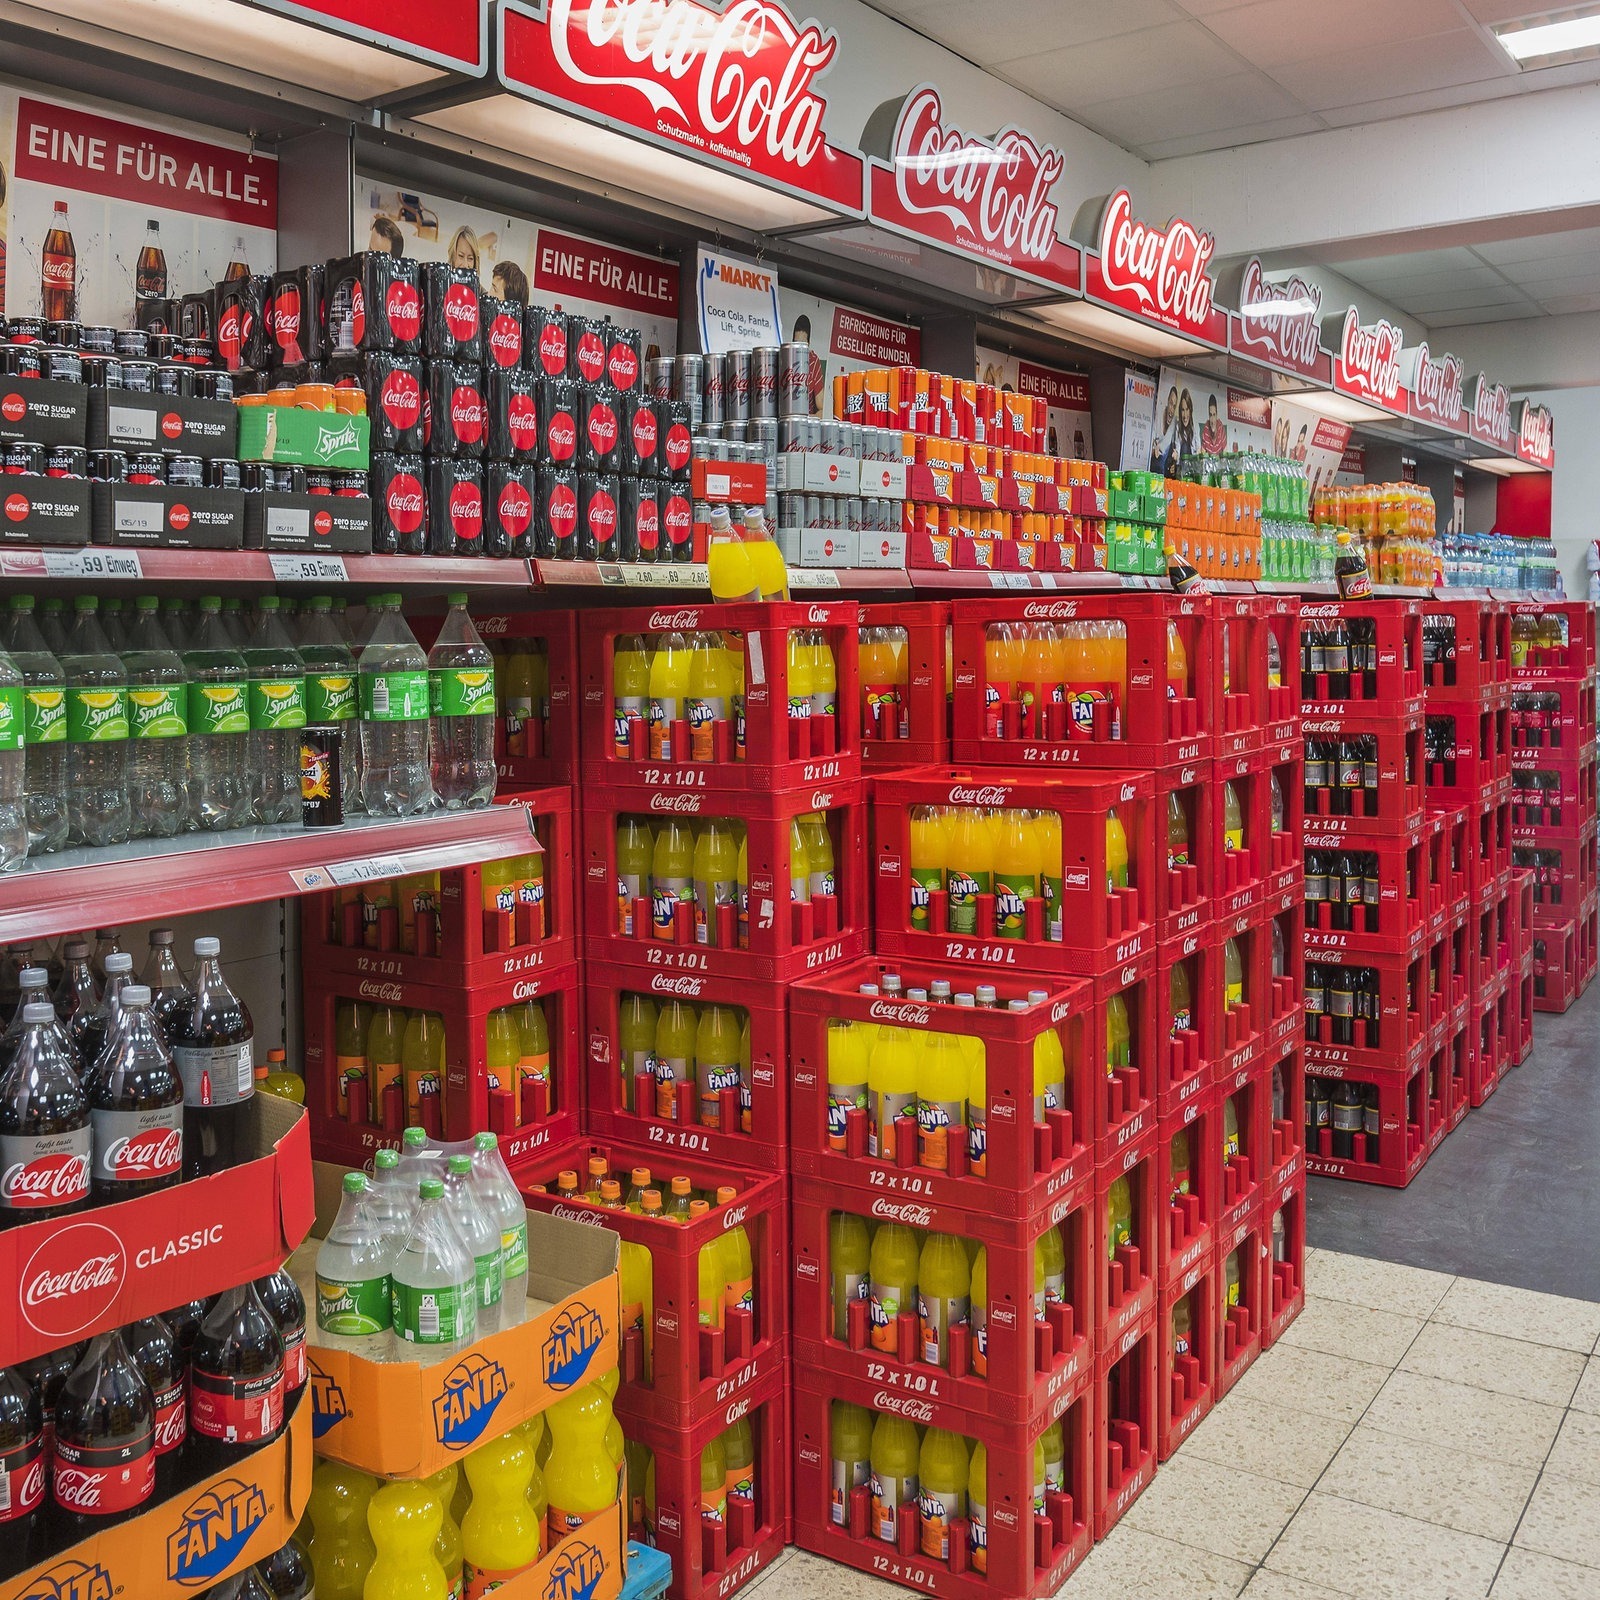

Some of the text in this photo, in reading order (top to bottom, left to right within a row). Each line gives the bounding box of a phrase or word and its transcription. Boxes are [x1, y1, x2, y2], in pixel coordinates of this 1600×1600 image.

[657, 119, 752, 166] Schutzmarke koffeinhaltig
[28, 124, 268, 207] EINE FÜR ALLE.
[541, 248, 673, 301] EINE FÜR ALLE.
[704, 257, 771, 293] V-MARKT
[145, 289, 158, 298] zero
[707, 305, 772, 328] Coca Cola, Fanta,
[721, 321, 761, 339] Lift, Sprite
[839, 314, 907, 345] ERFRISCHUNG FÜR
[837, 335, 913, 366] GESELLIGE RUNDEN.
[1020, 376, 1087, 402] EINE FÜR ALLE.
[28, 403, 76, 415] zero SUGAR
[116, 425, 141, 435] 05/19
[184, 421, 226, 432] zero SUGAR
[320, 432, 357, 453] Sprite
[31, 502, 80, 513] zero SUGAR
[192, 512, 234, 521] zero SUGAR
[121, 519, 148, 528] 05/19
[333, 518, 350, 526] zero
[105, 555, 137, 577] Einweg
[318, 561, 343, 580] Einweg
[808, 605, 829, 623] Coke
[89, 701, 123, 725] Sprite
[137, 699, 174, 723] Sprite
[211, 696, 244, 718] Sprite
[269, 692, 301, 714] Sprite
[1023, 748, 1080, 762] 12 x 1.0 L
[644, 770, 706, 786] 12 x 1.0 L
[803, 765, 813, 781] 12
[834, 762, 840, 776] L
[811, 791, 832, 809] Coke
[504, 959, 514, 974] 12
[537, 951, 544, 964] L
[946, 943, 1016, 963] 12 x 1.0 L
[512, 981, 538, 1000] Coke
[1051, 1003, 1069, 1023] Coke
[649, 1126, 709, 1151] 12 x 1.0 L
[869, 1170, 933, 1195] 12 x 1.0 L
[723, 1206, 747, 1229] Coke
[1052, 1201, 1069, 1223] Coke
[135, 1224, 223, 1269] CLASSIC
[27, 1252, 120, 1305] Coca-Cola
[320, 1298, 354, 1316] Sprite
[542, 1308, 603, 1383] FANTA
[433, 1361, 508, 1442] FANTA
[121, 1447, 131, 1457] 2L
[167, 1484, 267, 1580] FANTA
